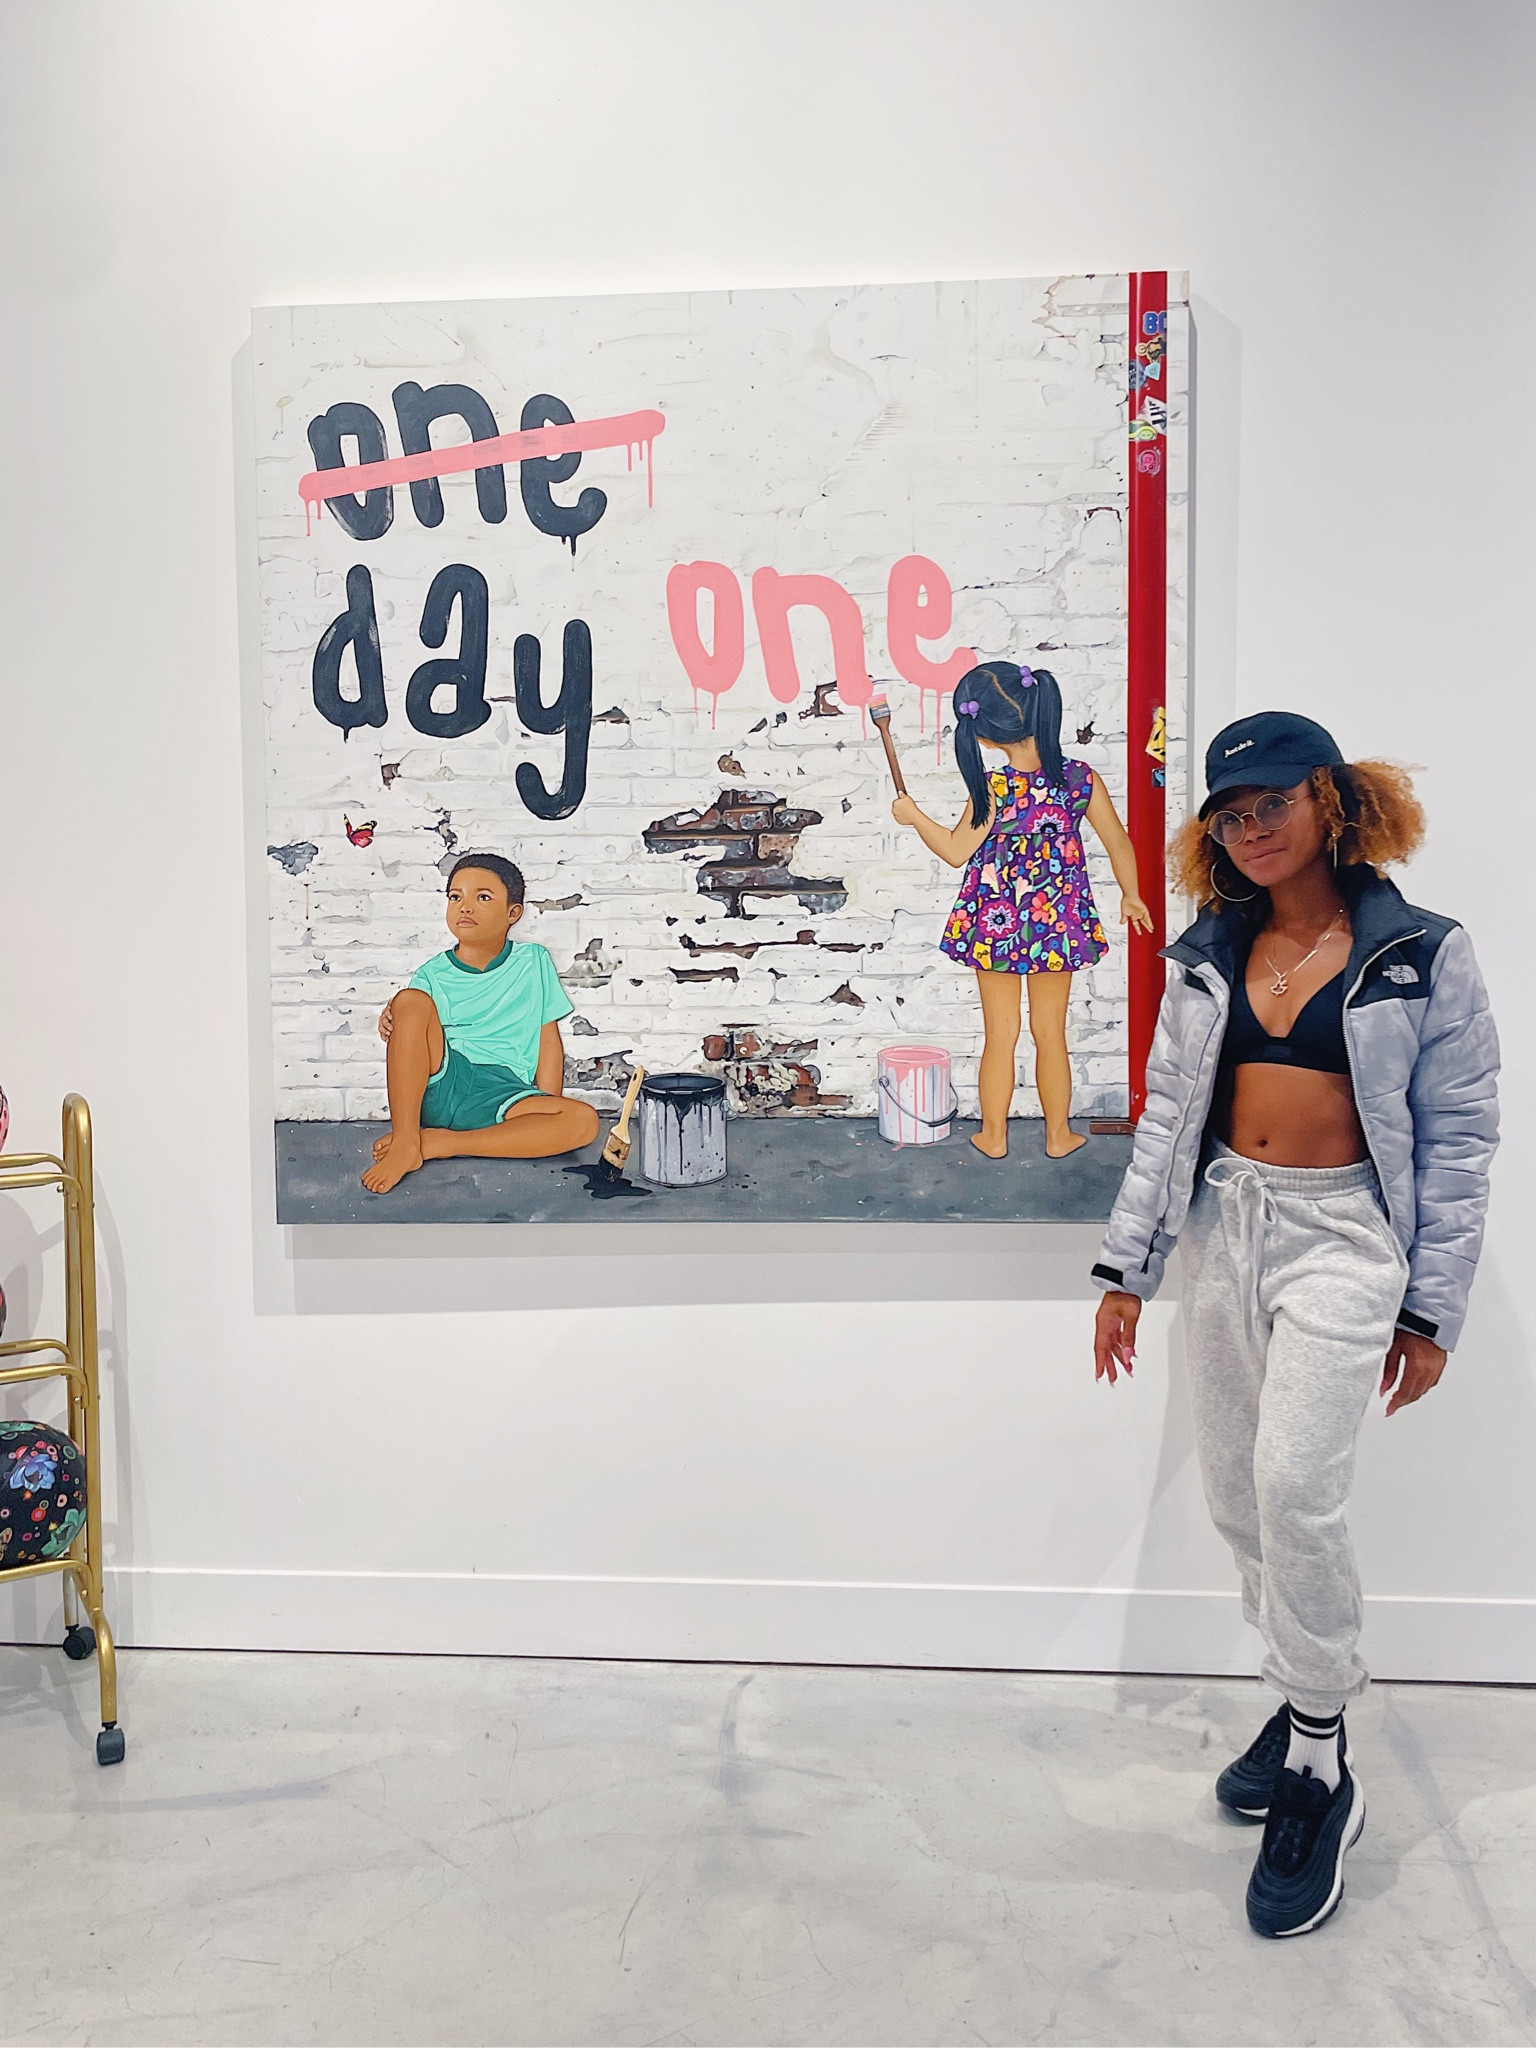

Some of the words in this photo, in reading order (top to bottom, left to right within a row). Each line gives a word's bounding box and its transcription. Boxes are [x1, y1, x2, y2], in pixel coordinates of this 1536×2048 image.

[307, 381, 608, 541] one
[312, 564, 592, 820] day
[667, 555, 978, 706] one
[1224, 746, 1238, 758] Just
